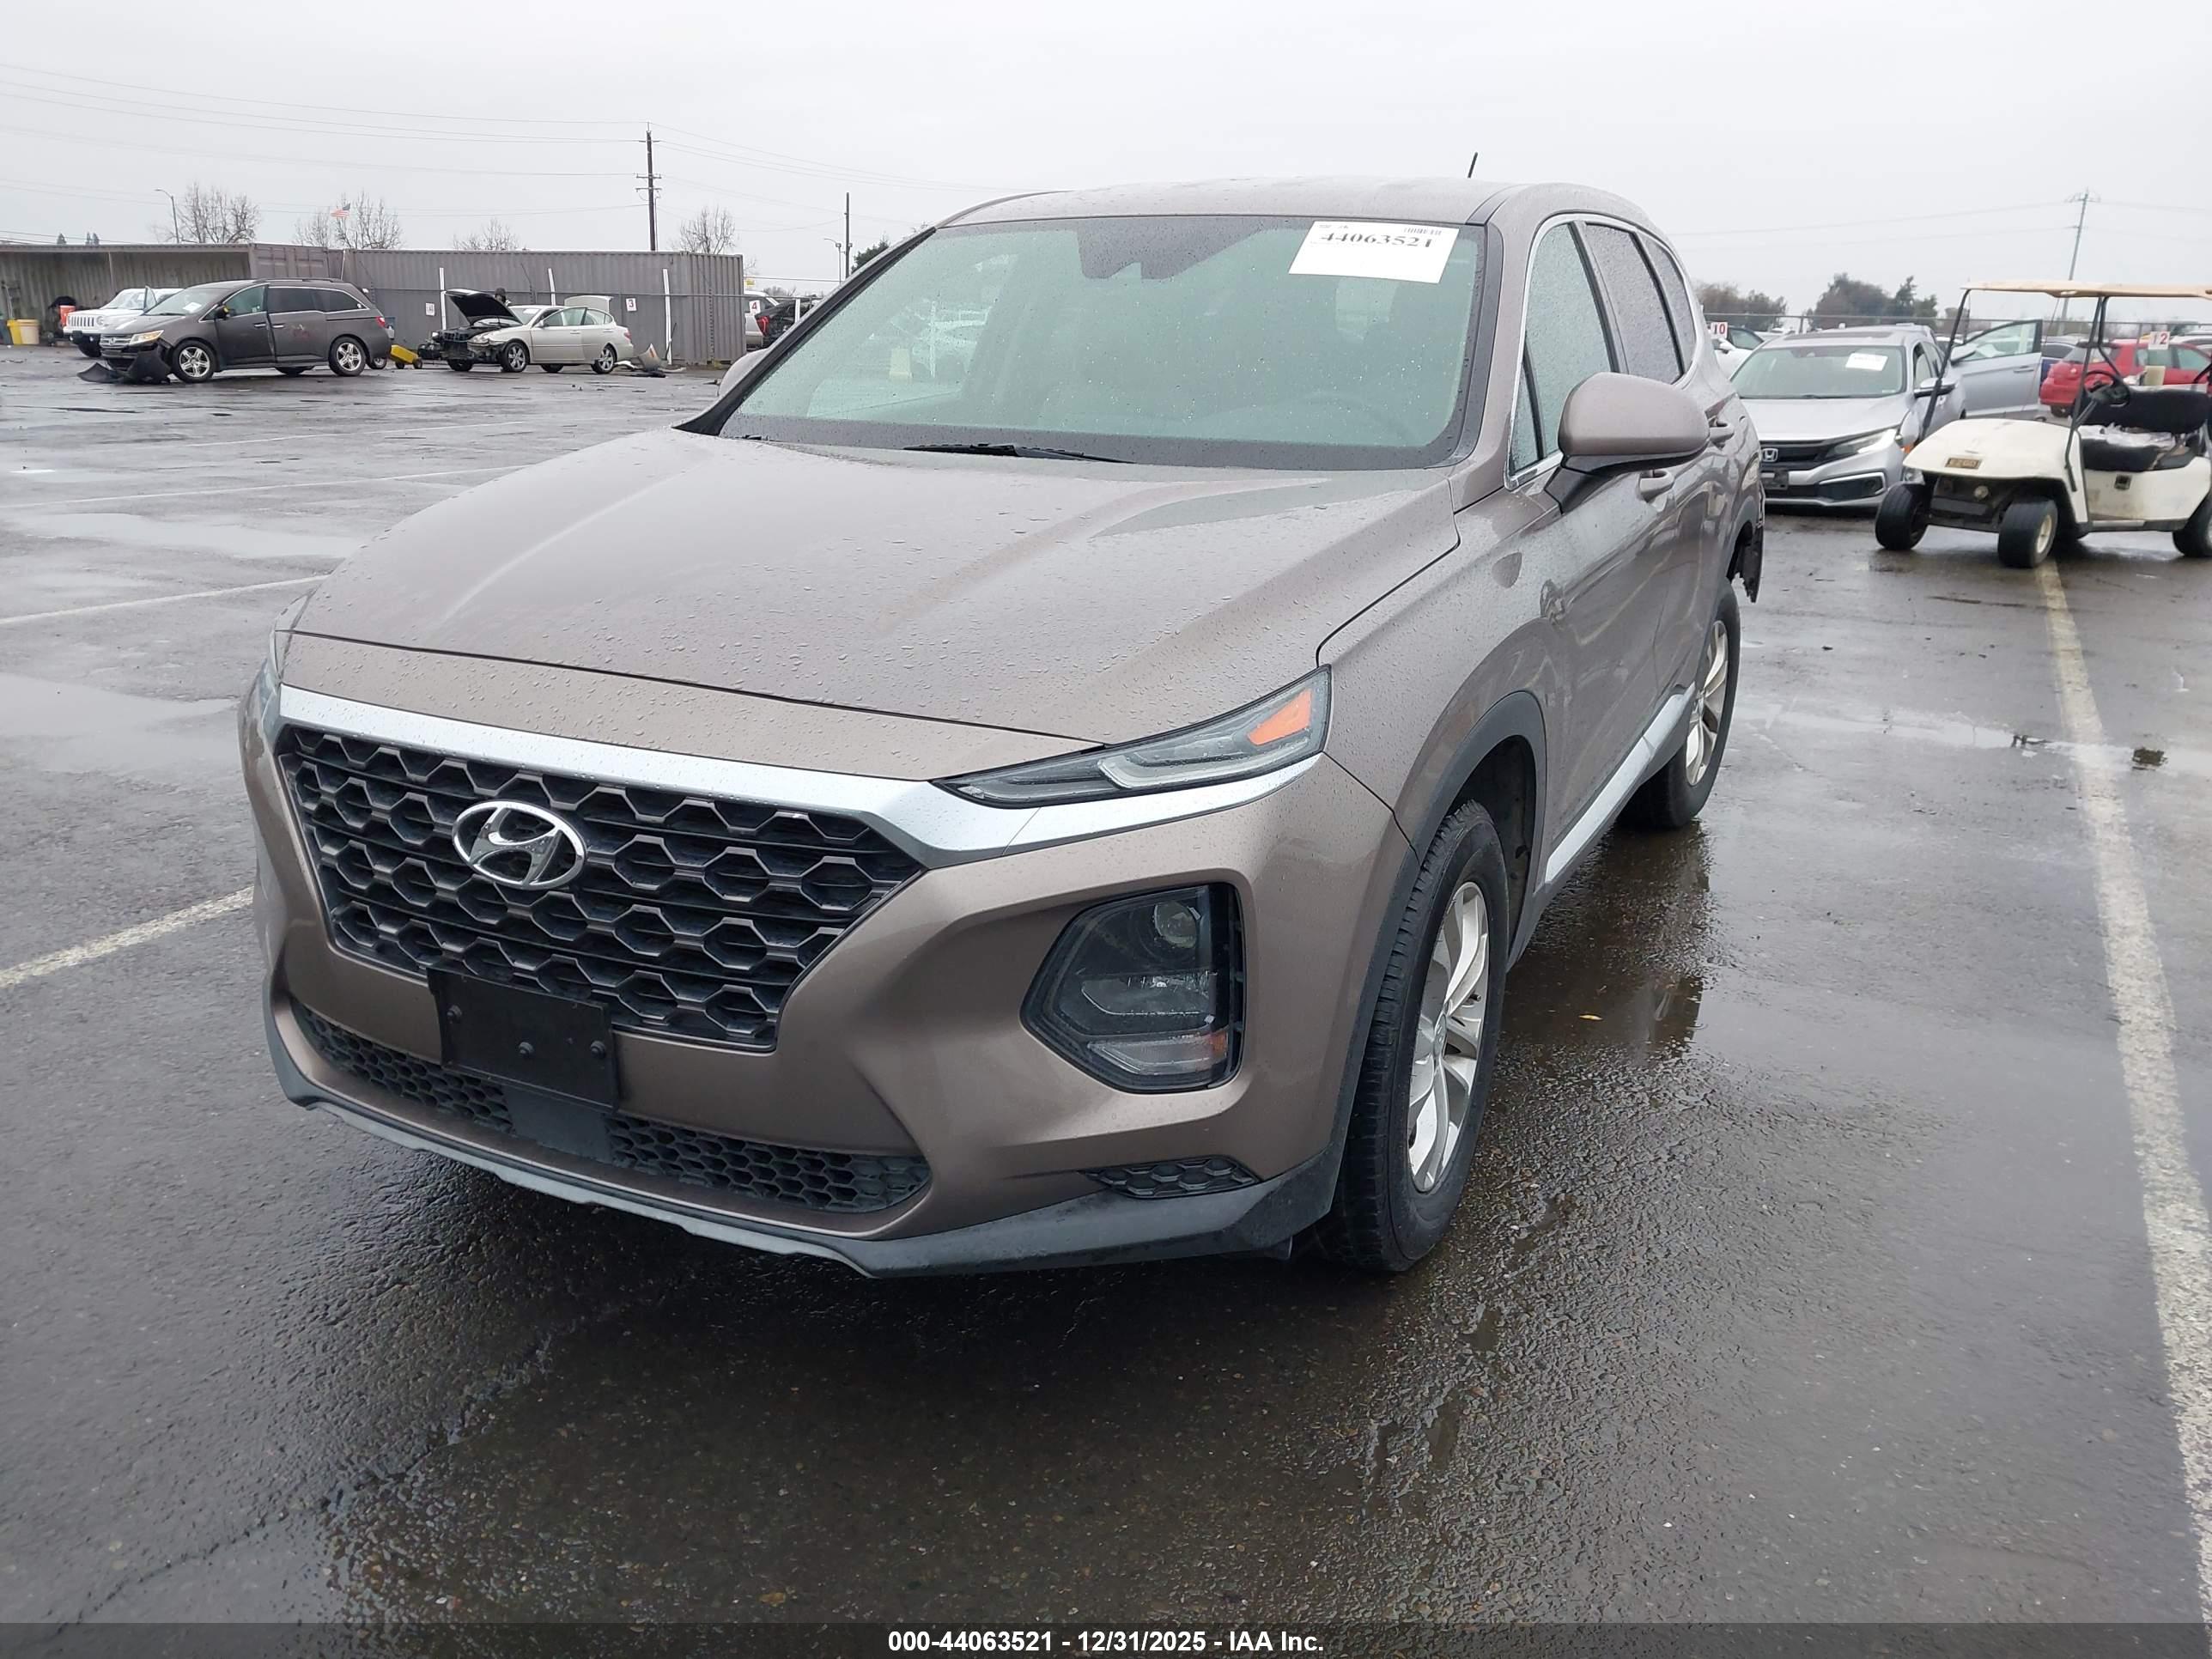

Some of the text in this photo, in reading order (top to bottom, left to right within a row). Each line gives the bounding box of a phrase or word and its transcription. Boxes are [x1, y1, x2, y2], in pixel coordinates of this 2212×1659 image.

[1321, 233, 1433, 248] 44063521
[751, 301, 757, 310] 4
[1713, 324, 1725, 335] 10
[2153, 332, 2168, 344] 12
